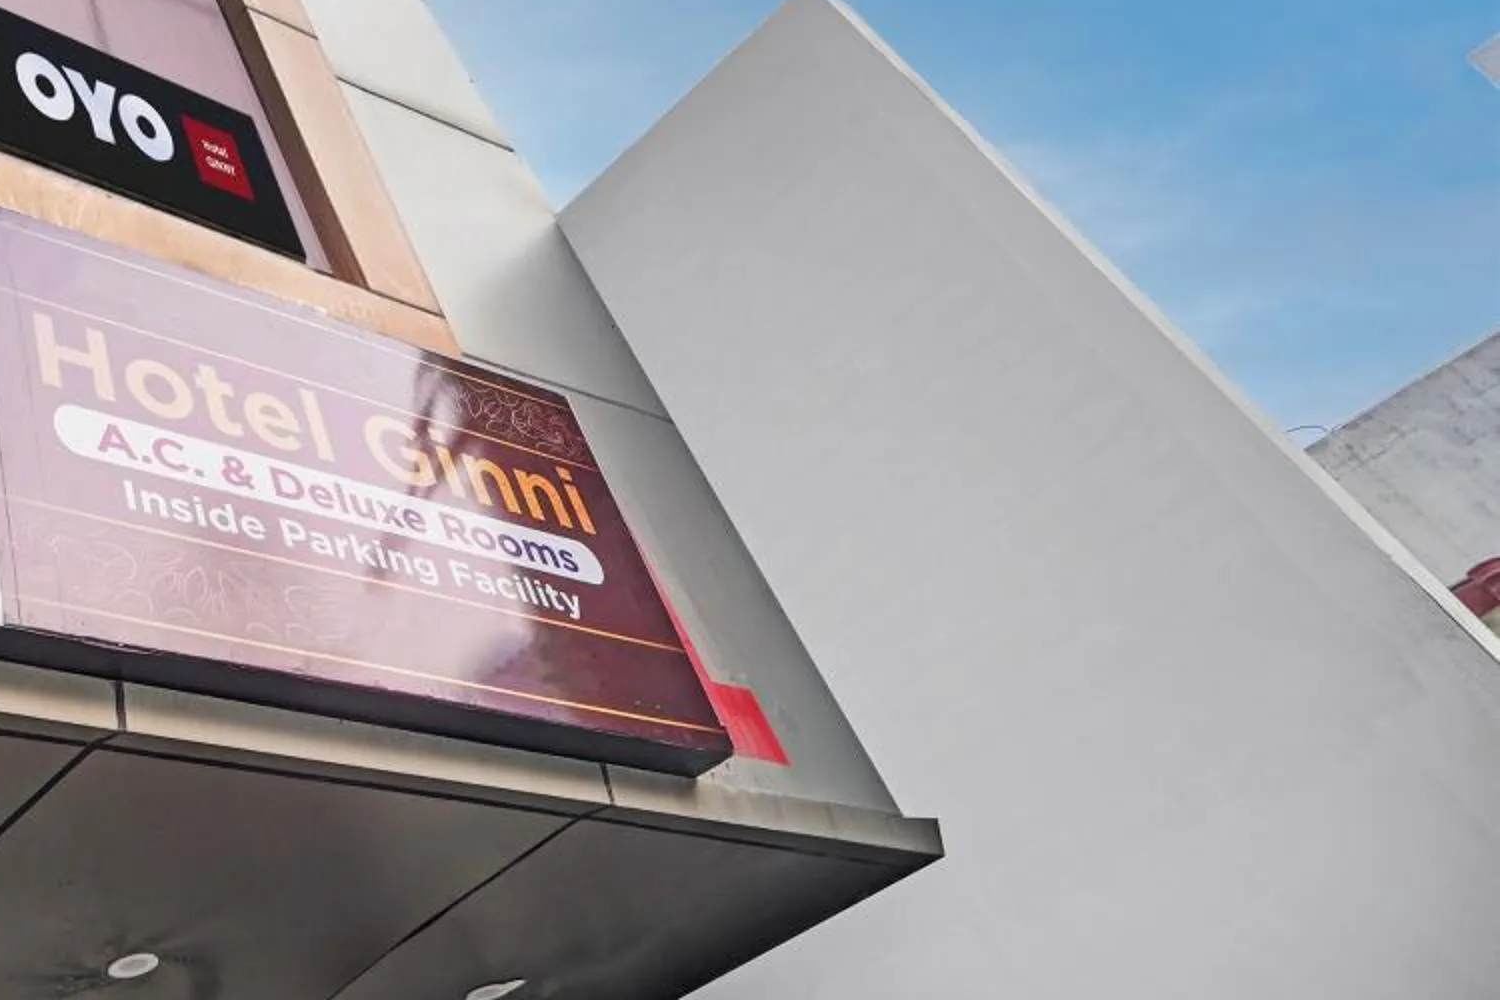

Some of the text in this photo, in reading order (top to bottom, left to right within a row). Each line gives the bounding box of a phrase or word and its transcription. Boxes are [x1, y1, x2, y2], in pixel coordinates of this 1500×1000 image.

[15, 51, 175, 162] OYO
[33, 312, 597, 535] Hotel Ginni
[98, 423, 579, 574] A.C. & Deluxe Rooms
[122, 480, 582, 620] Inside Parking Facility
